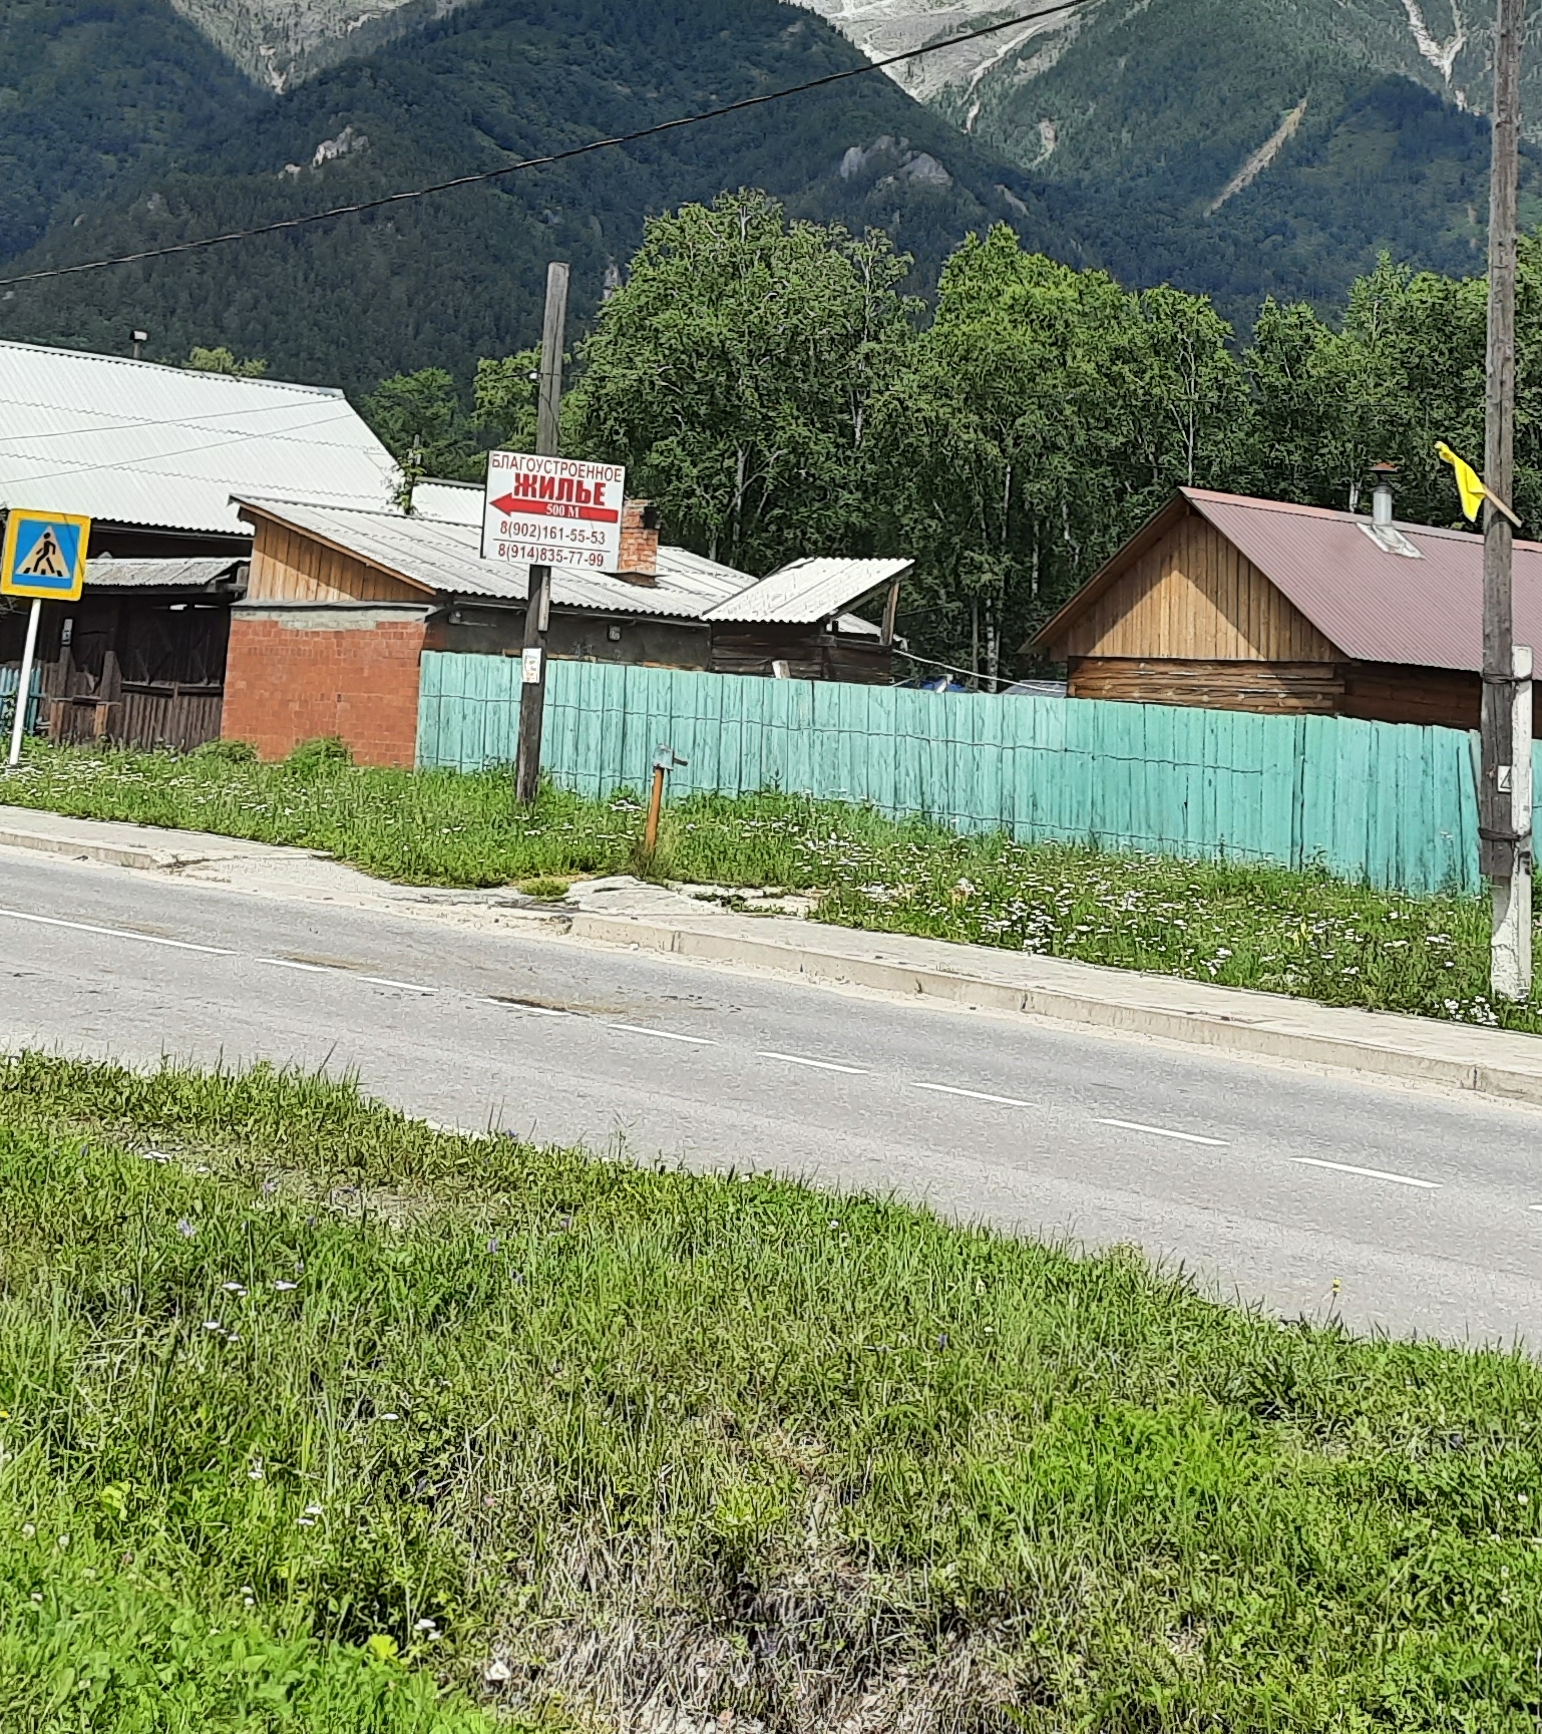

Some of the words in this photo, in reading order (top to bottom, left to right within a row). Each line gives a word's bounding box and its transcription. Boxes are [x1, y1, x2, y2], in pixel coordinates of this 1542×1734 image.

[492, 454, 622, 483] БЛАГОУСТРОЕННОЕ
[514, 473, 606, 506] ЖИЛЬЕ
[546, 505, 566, 516] 500
[500, 521, 606, 545] 8(902)161-55-53
[498, 543, 604, 566] 8(914)835-77-99
